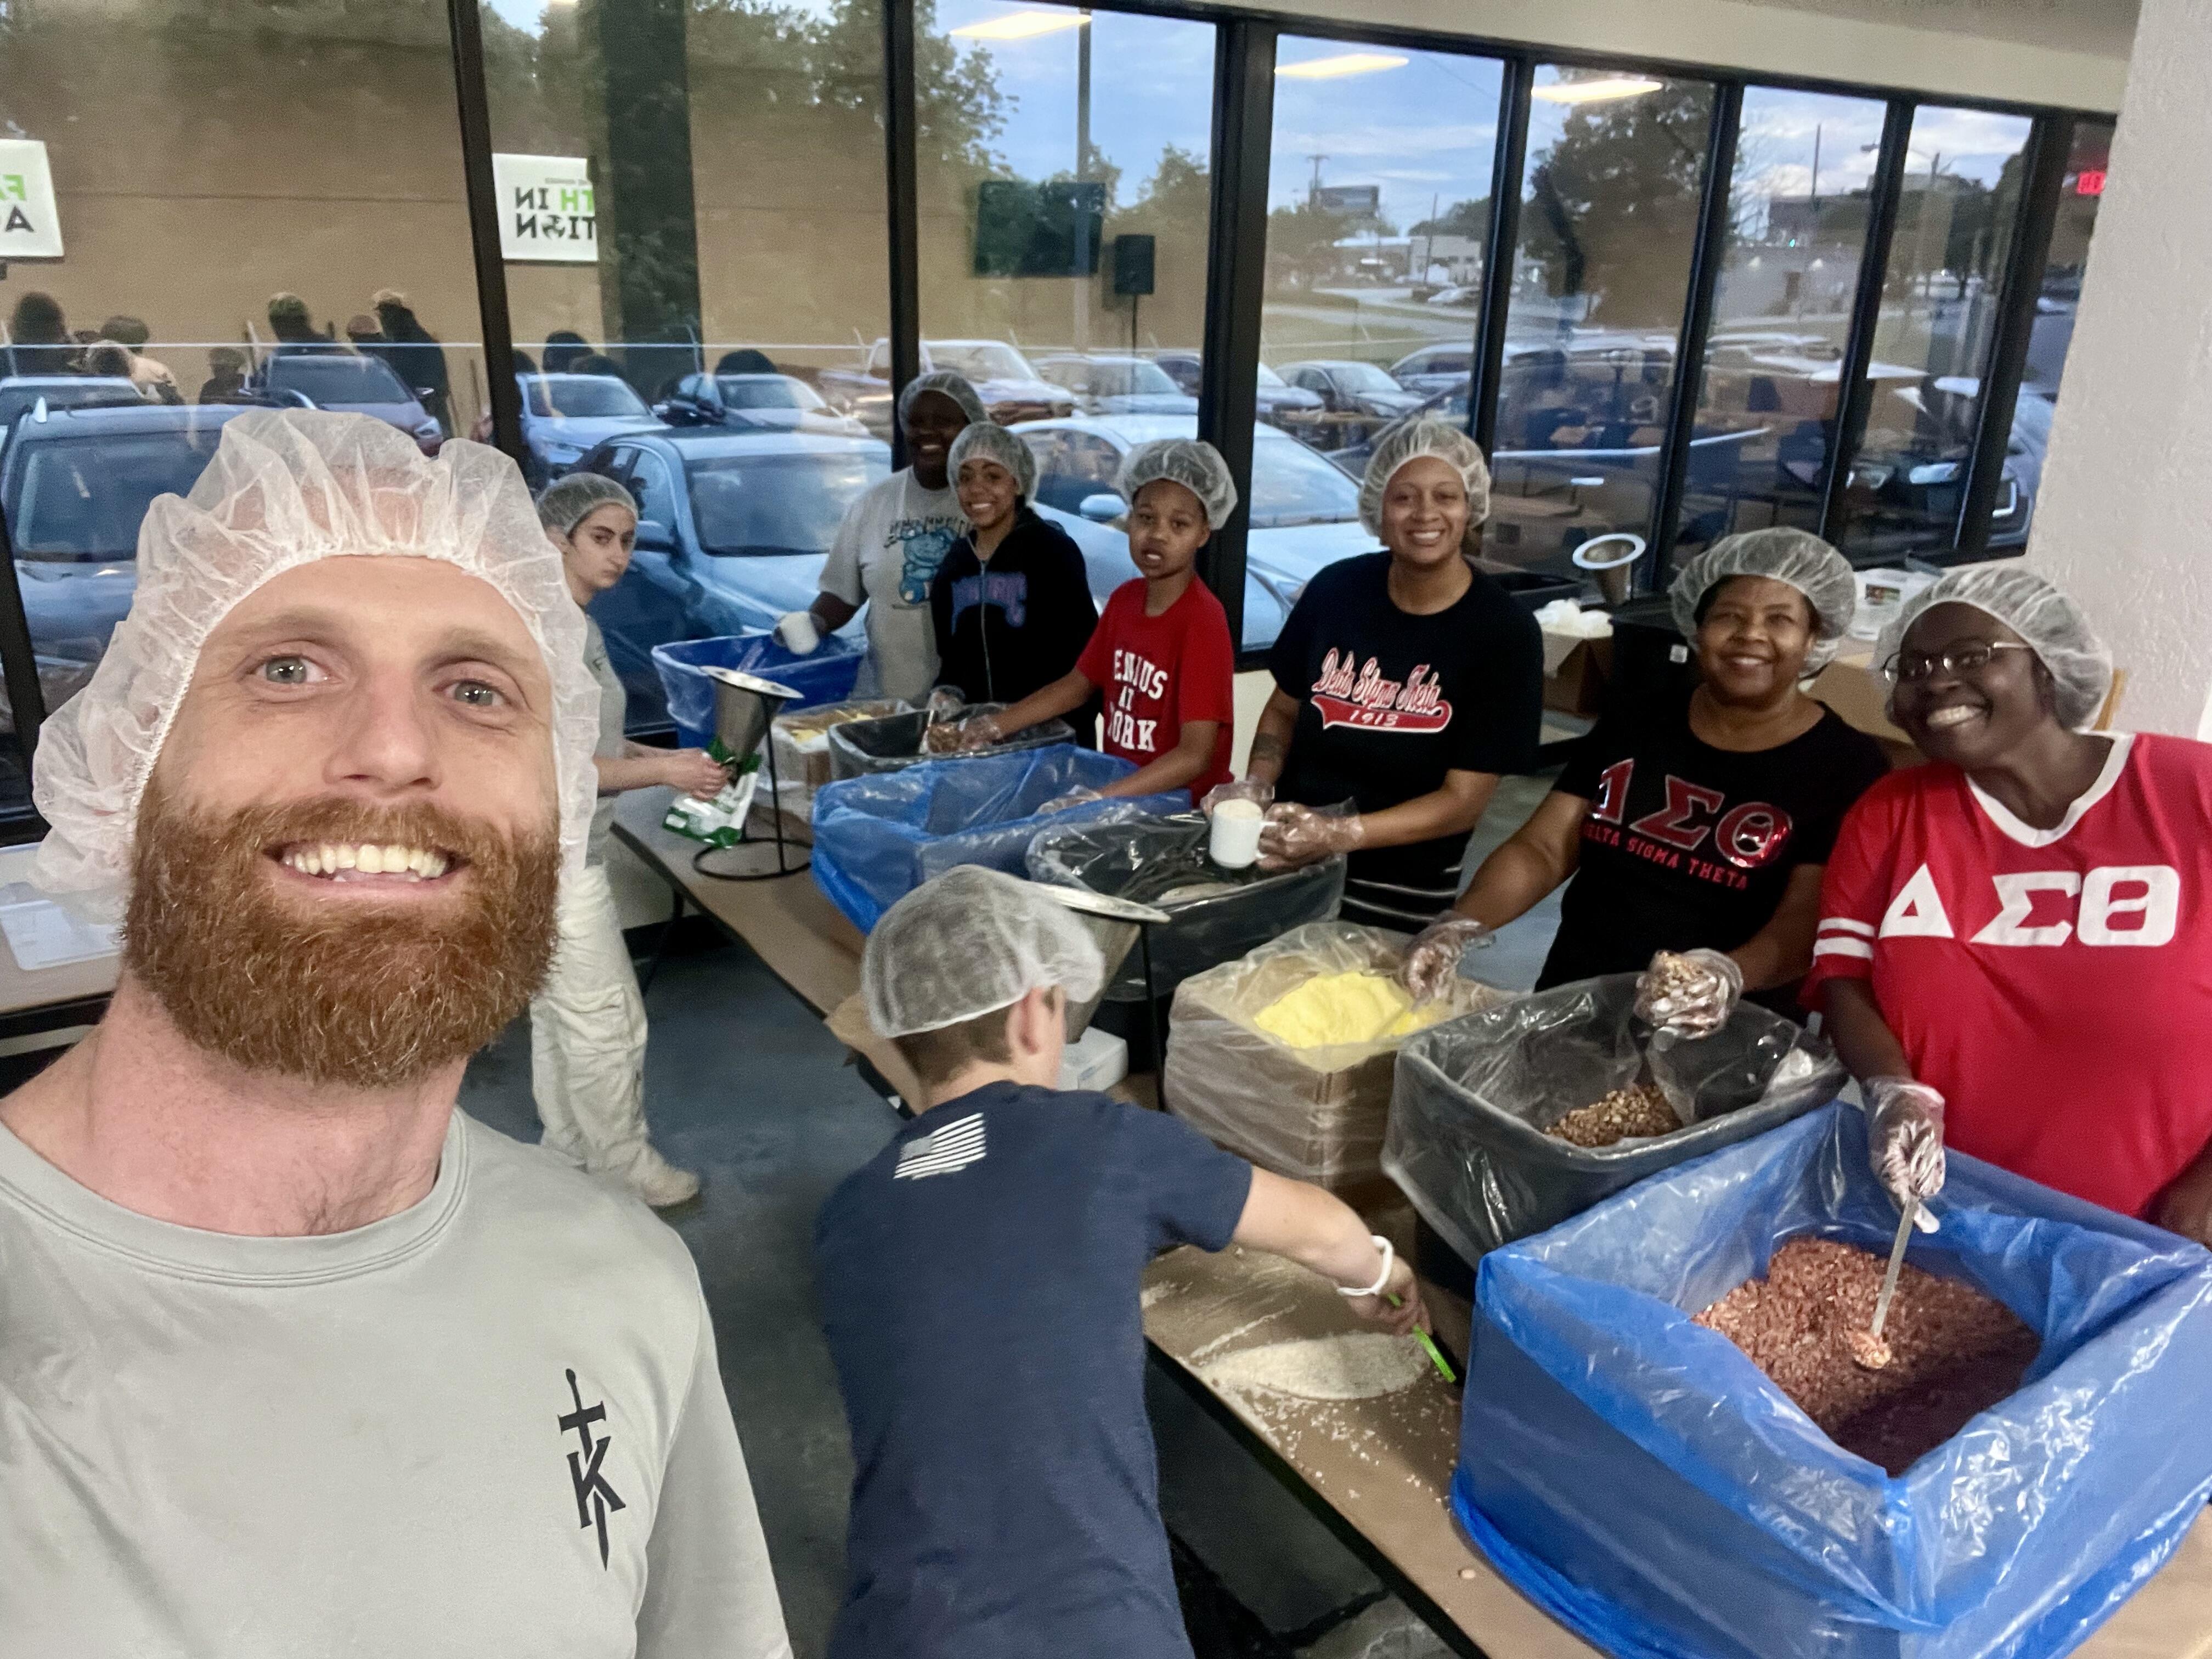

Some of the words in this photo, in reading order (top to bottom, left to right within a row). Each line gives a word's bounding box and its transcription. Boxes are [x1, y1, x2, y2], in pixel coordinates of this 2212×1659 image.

[1350, 710, 1399, 726] 1913
[1626, 836, 1679, 869] SIGMA
[1689, 857, 1749, 890] THETA
